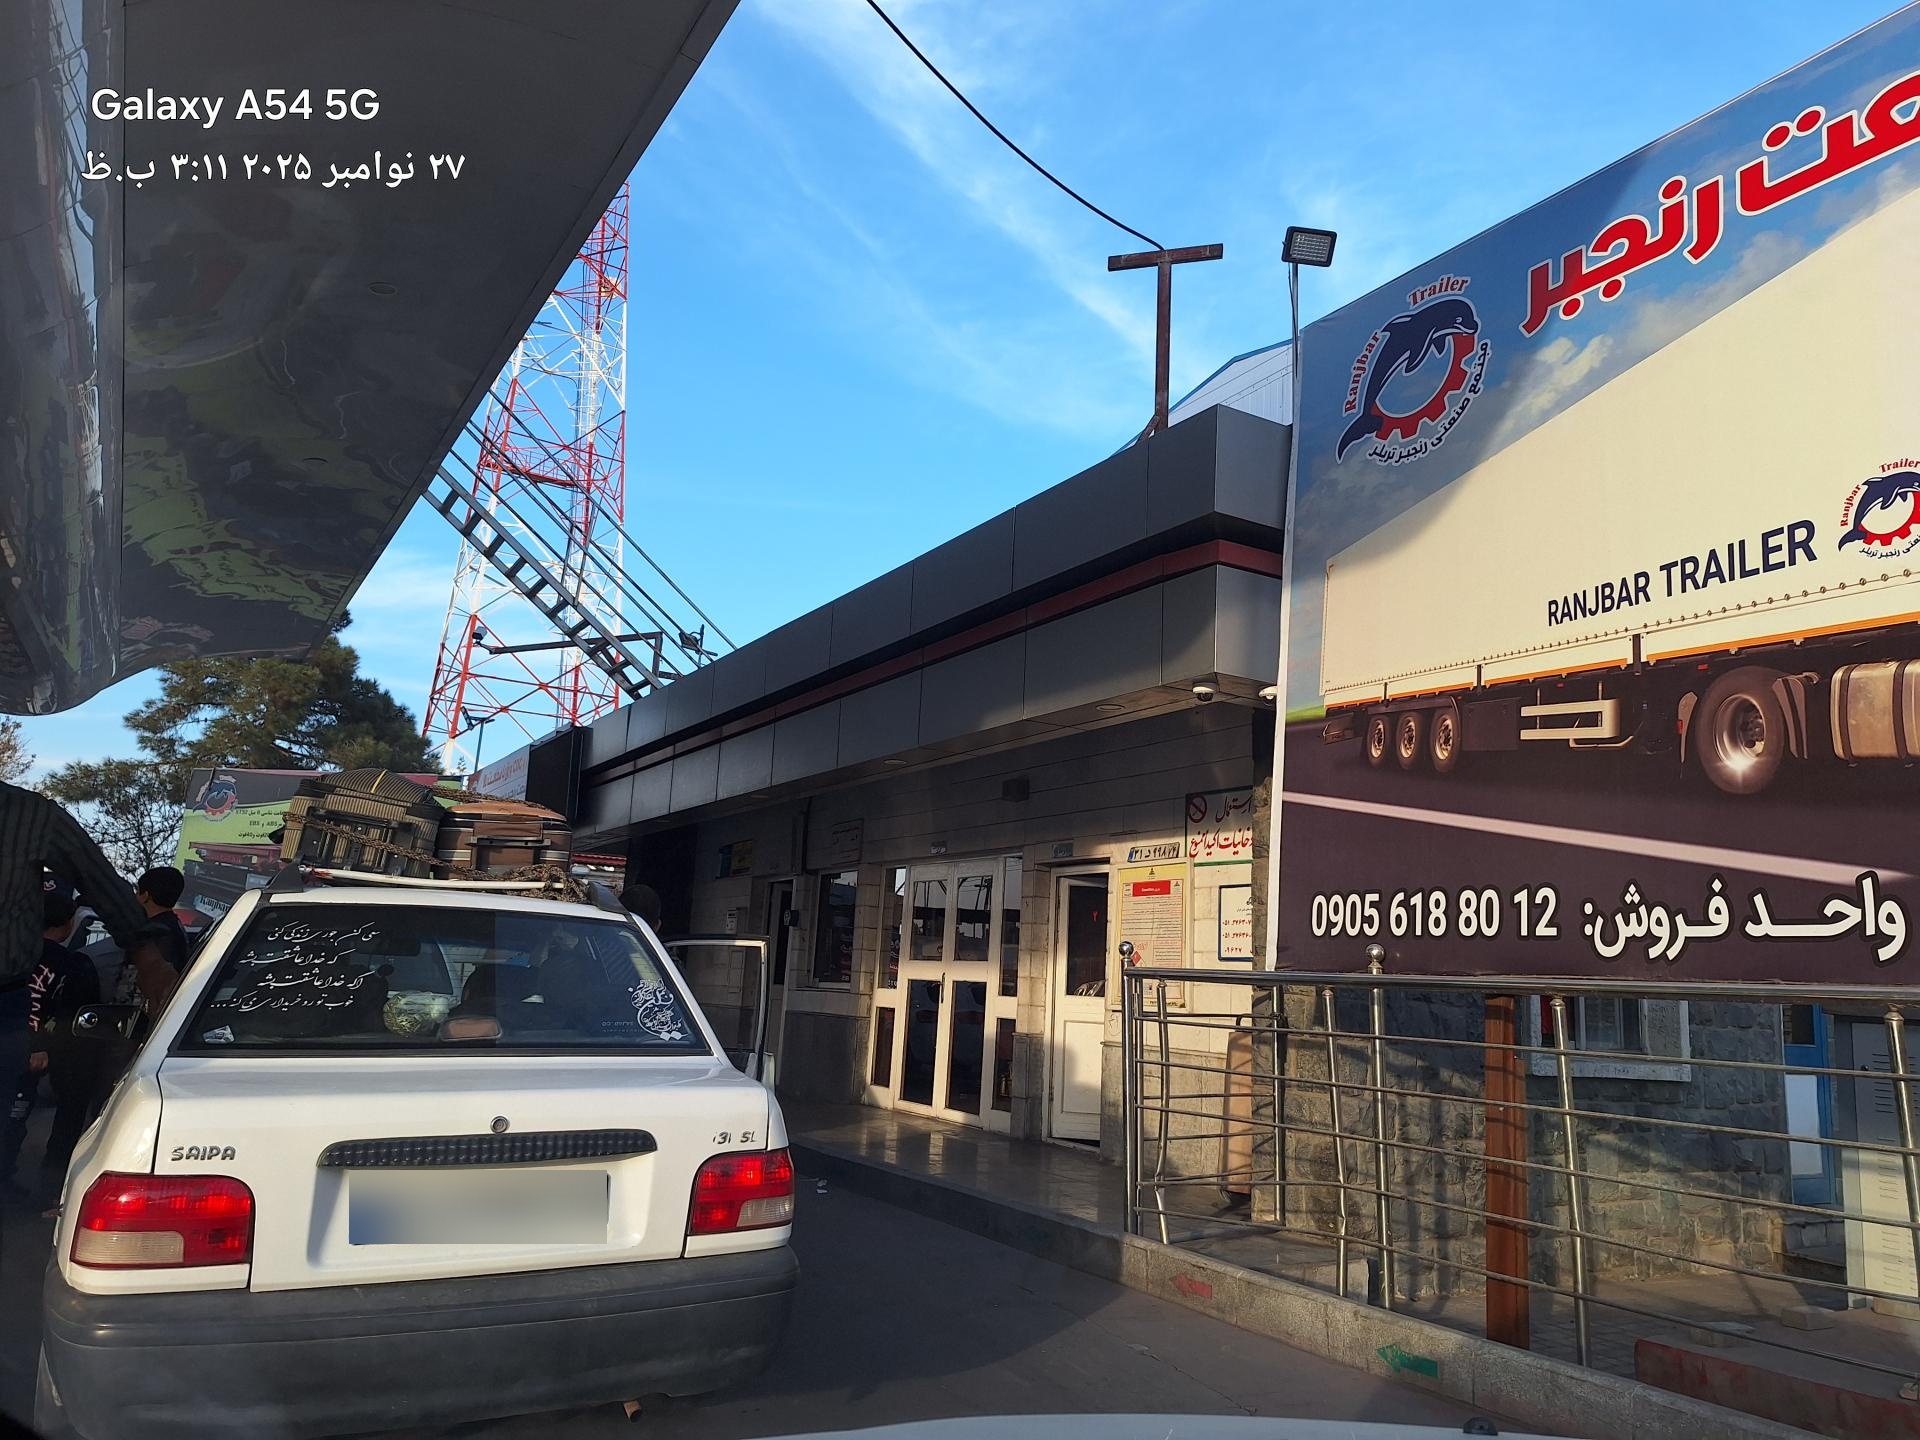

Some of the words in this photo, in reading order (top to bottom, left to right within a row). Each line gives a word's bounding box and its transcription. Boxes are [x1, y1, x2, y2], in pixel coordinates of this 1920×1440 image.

[1518, 175, 1724, 338] رنجبر
[1344, 331, 1381, 414] Ranjbar
[1407, 275, 1470, 307] Trailer
[1840, 484, 1861, 527] Ranjbar
[1548, 571, 1651, 627] RANJBAR
[1659, 519, 1817, 597] TRAILER
[1311, 893, 1380, 936] 0905
[1389, 890, 1447, 936] 618
[1458, 889, 1500, 936] 80
[1513, 887, 1558, 936] 12
[1583, 878, 1730, 961] فروش:
[1744, 876, 1907, 962] واحد
[171, 1145, 237, 1161] SAIPA
